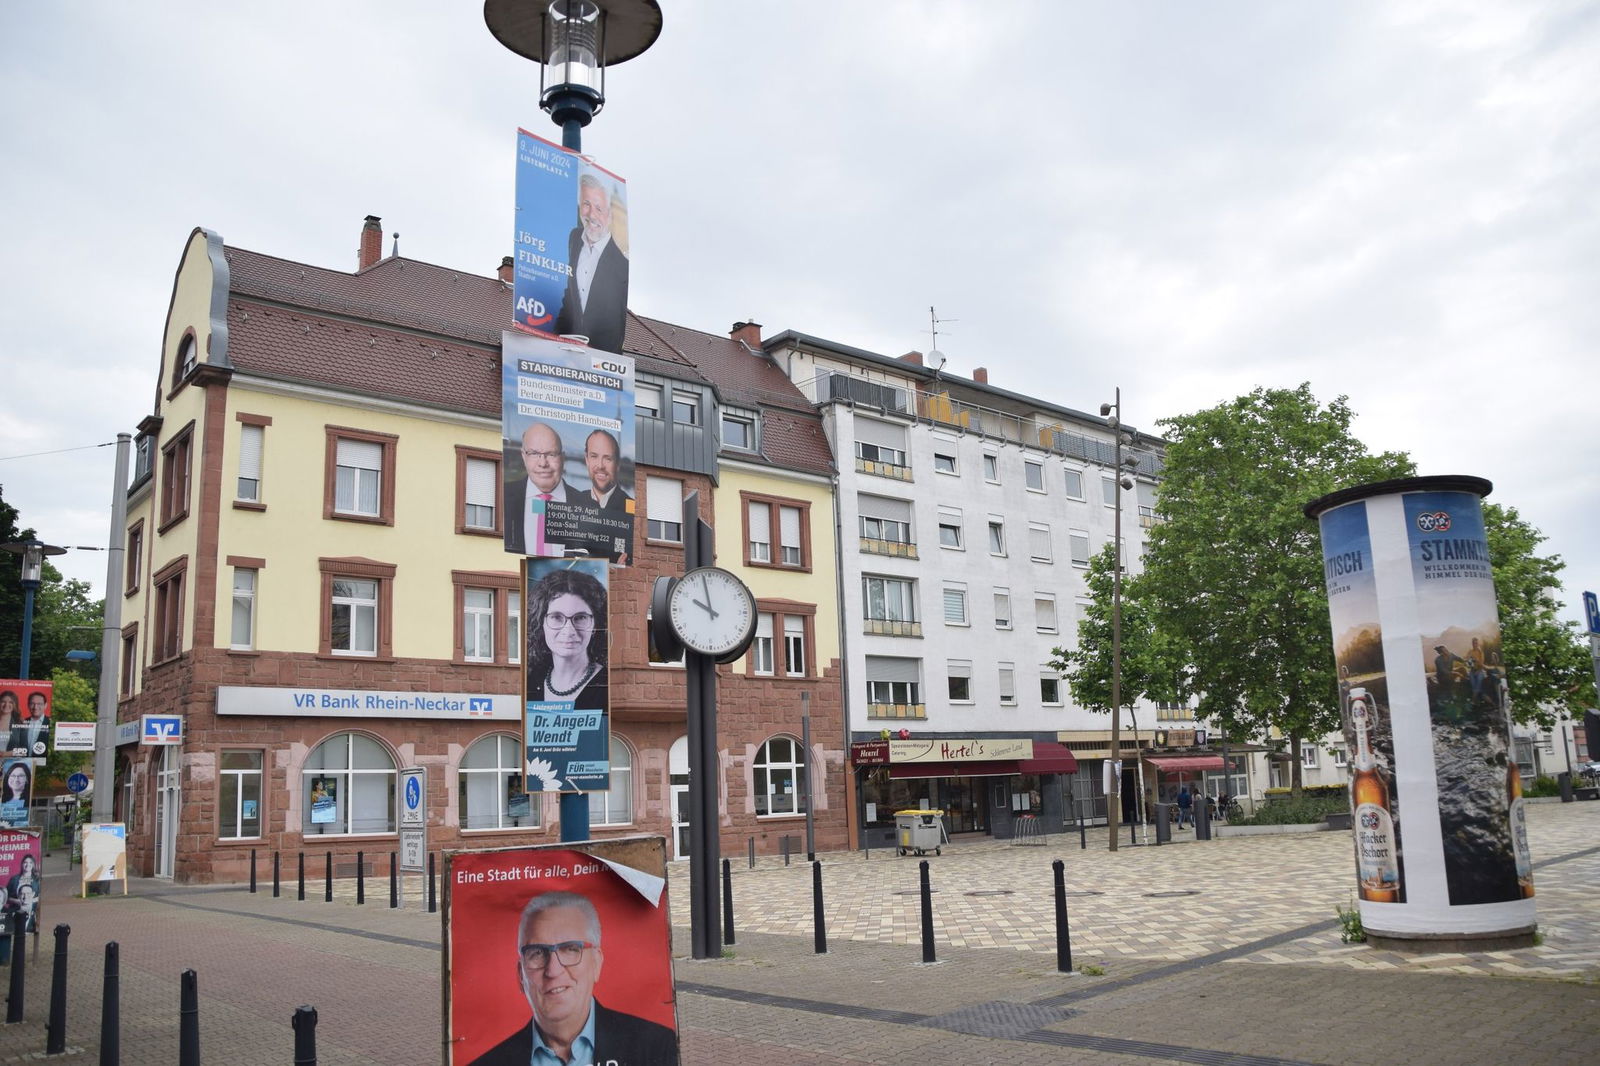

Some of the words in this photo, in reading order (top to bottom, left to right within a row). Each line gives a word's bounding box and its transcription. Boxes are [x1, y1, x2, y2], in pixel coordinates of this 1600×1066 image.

[530, 144, 549, 160] JUNI
[551, 152, 570, 168] 2024
[519, 231, 546, 252] Jörg
[519, 249, 574, 278] FINKLER
[516, 296, 546, 316] AfD
[520, 360, 620, 388] STARKBIERANSTICH
[602, 362, 626, 374] CDU
[520, 378, 587, 397] Bundesminister
[588, 391, 603, 400] a.D.
[520, 389, 543, 400] Peter
[545, 392, 582, 406] Altmaier
[520, 405, 534, 414] Dr.
[534, 406, 576, 422] Christoph
[578, 414, 620, 430] Hambusch
[547, 503, 573, 512] Montag,
[584, 508, 598, 516] April
[548, 512, 566, 520] 19:00
[547, 520, 578, 528] Jona-Saal
[546, 529, 587, 538] Viernheimer
[588, 532, 599, 542] Weg
[1424, 564, 1479, 572] WILLKOMMEN
[1588, 596, 1596, 628] P
[294, 694, 316, 708] VR
[322, 694, 360, 708] Bank
[366, 695, 466, 711] Rhein-Neckar
[534, 716, 549, 728] Dr.
[552, 714, 596, 730] Angela
[533, 730, 572, 743] Wendt
[942, 740, 984, 760] Hertel's
[568, 762, 585, 772] FÜR
[457, 871, 484, 884] Eine
[488, 868, 521, 882] Stadt
[524, 866, 542, 879] für
[544, 865, 570, 878] alle,
[574, 862, 599, 876] Dein
